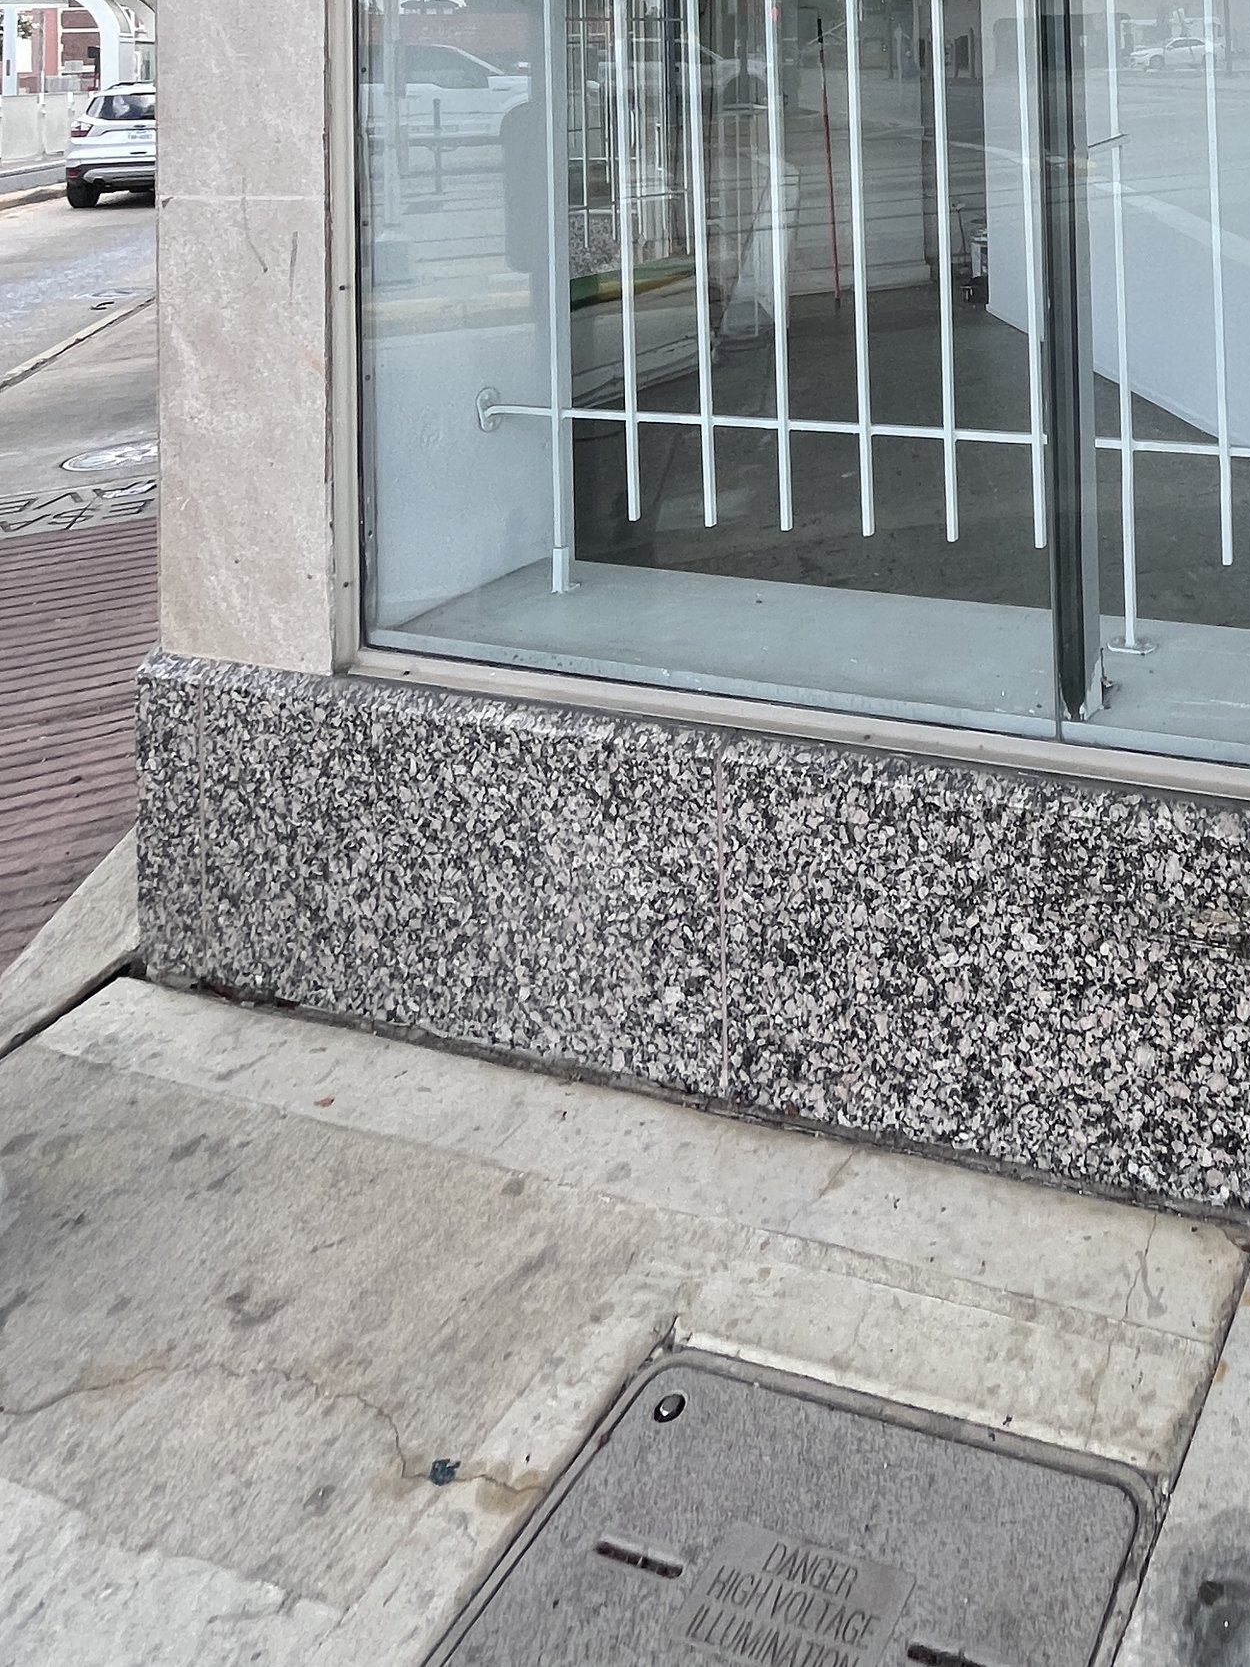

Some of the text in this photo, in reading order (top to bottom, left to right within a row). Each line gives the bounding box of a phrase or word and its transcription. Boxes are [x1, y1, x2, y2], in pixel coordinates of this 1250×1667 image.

[761, 1542, 858, 1598] DANGER
[706, 1565, 881, 1650] HIGH VOLTAGE
